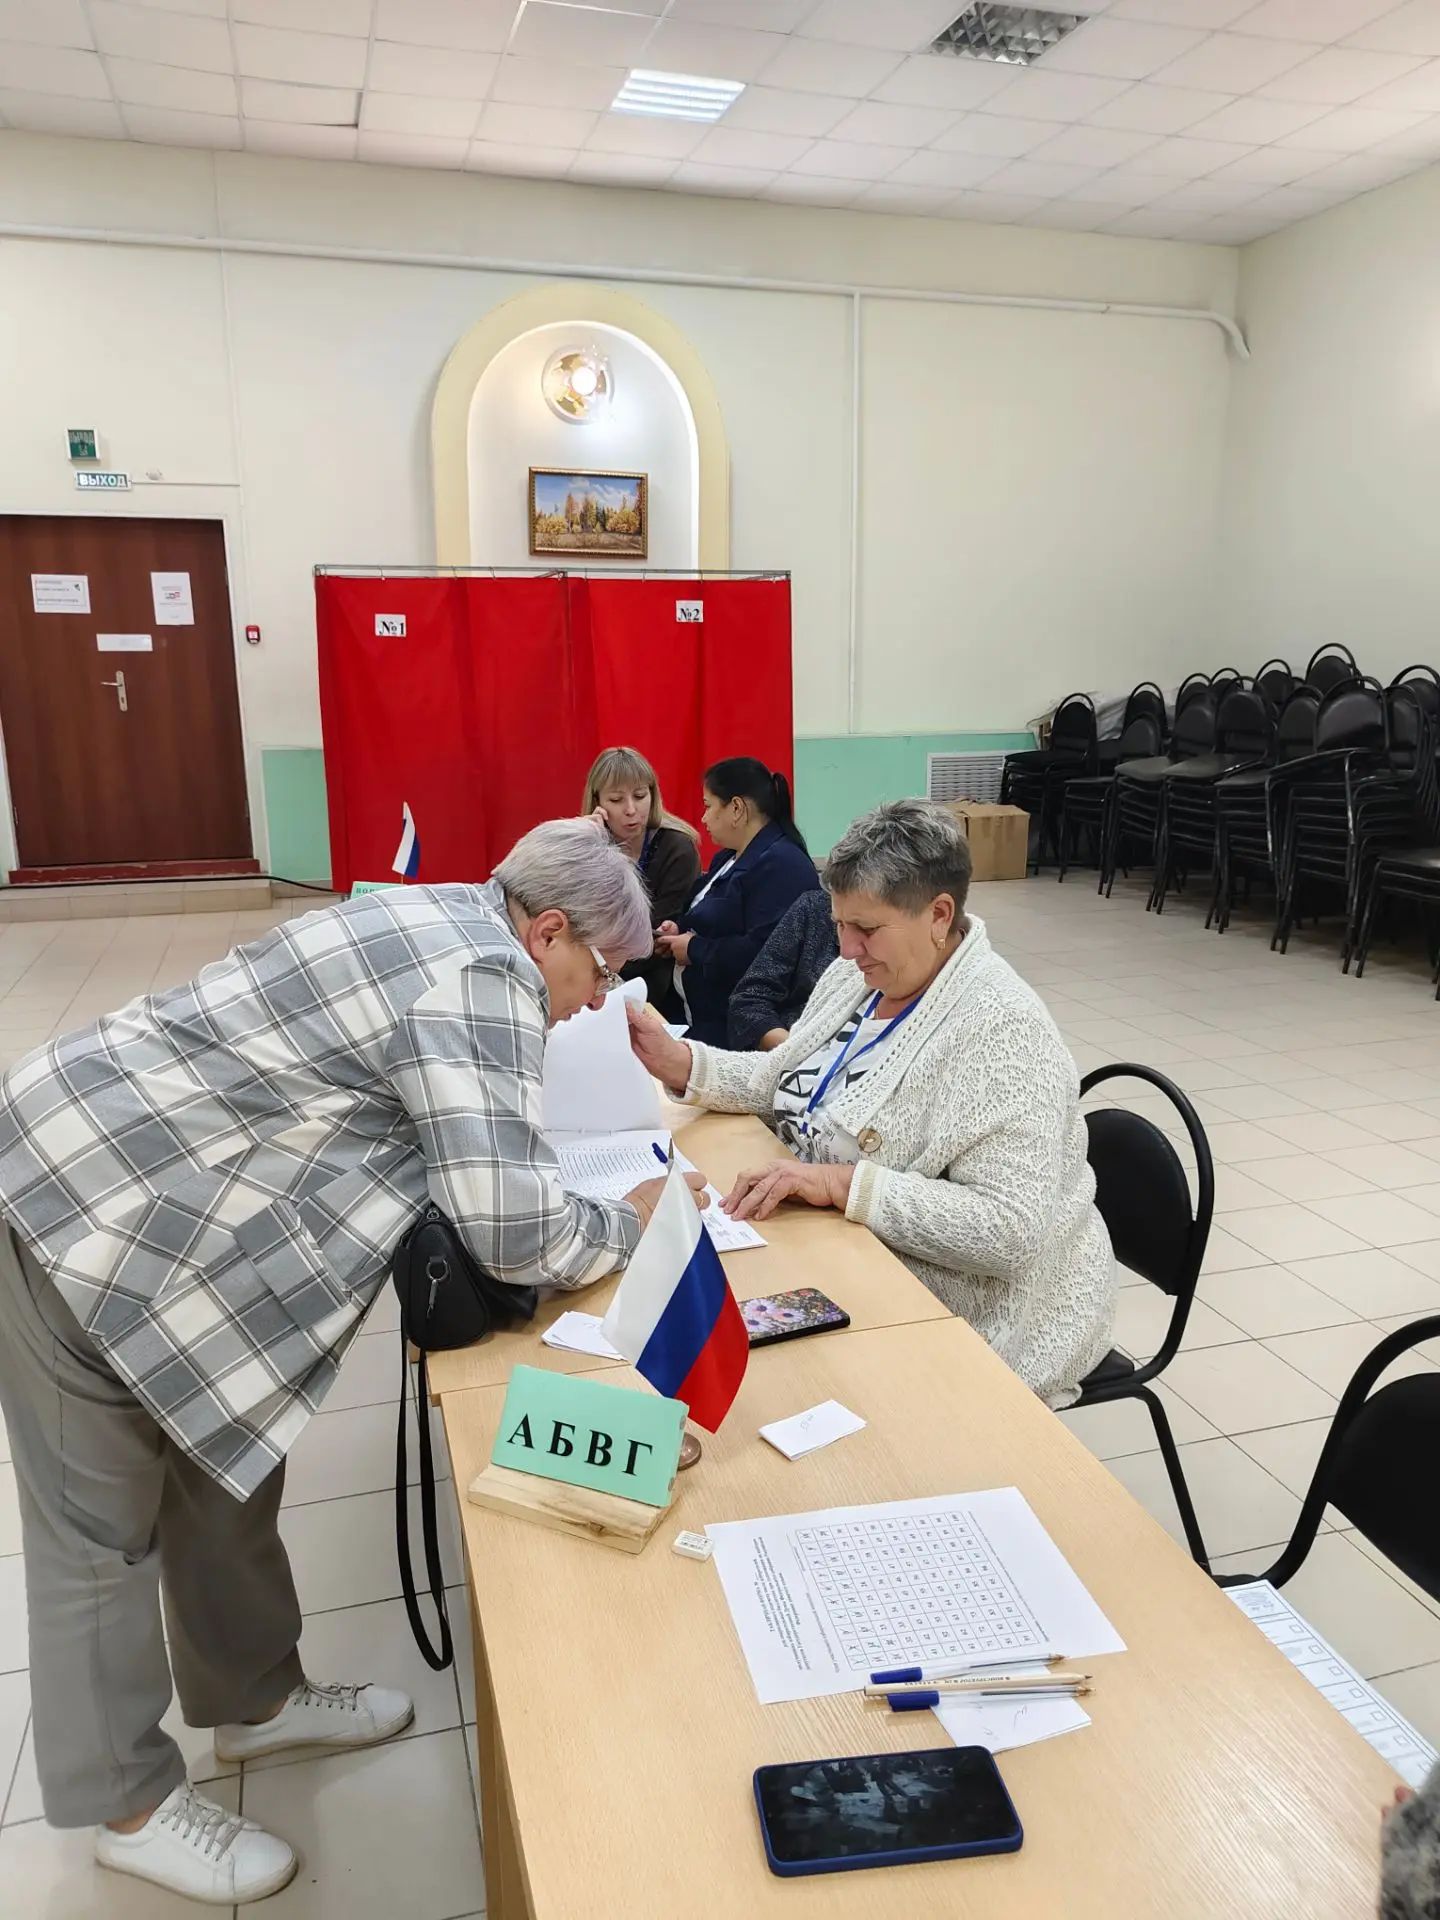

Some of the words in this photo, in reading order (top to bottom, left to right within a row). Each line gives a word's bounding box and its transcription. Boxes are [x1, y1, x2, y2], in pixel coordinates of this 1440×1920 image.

[79, 474, 127, 488] ВЫХОД
[678, 607, 700, 622] №2
[379, 620, 404, 636] №1
[506, 1412, 654, 1477] АБВГ
